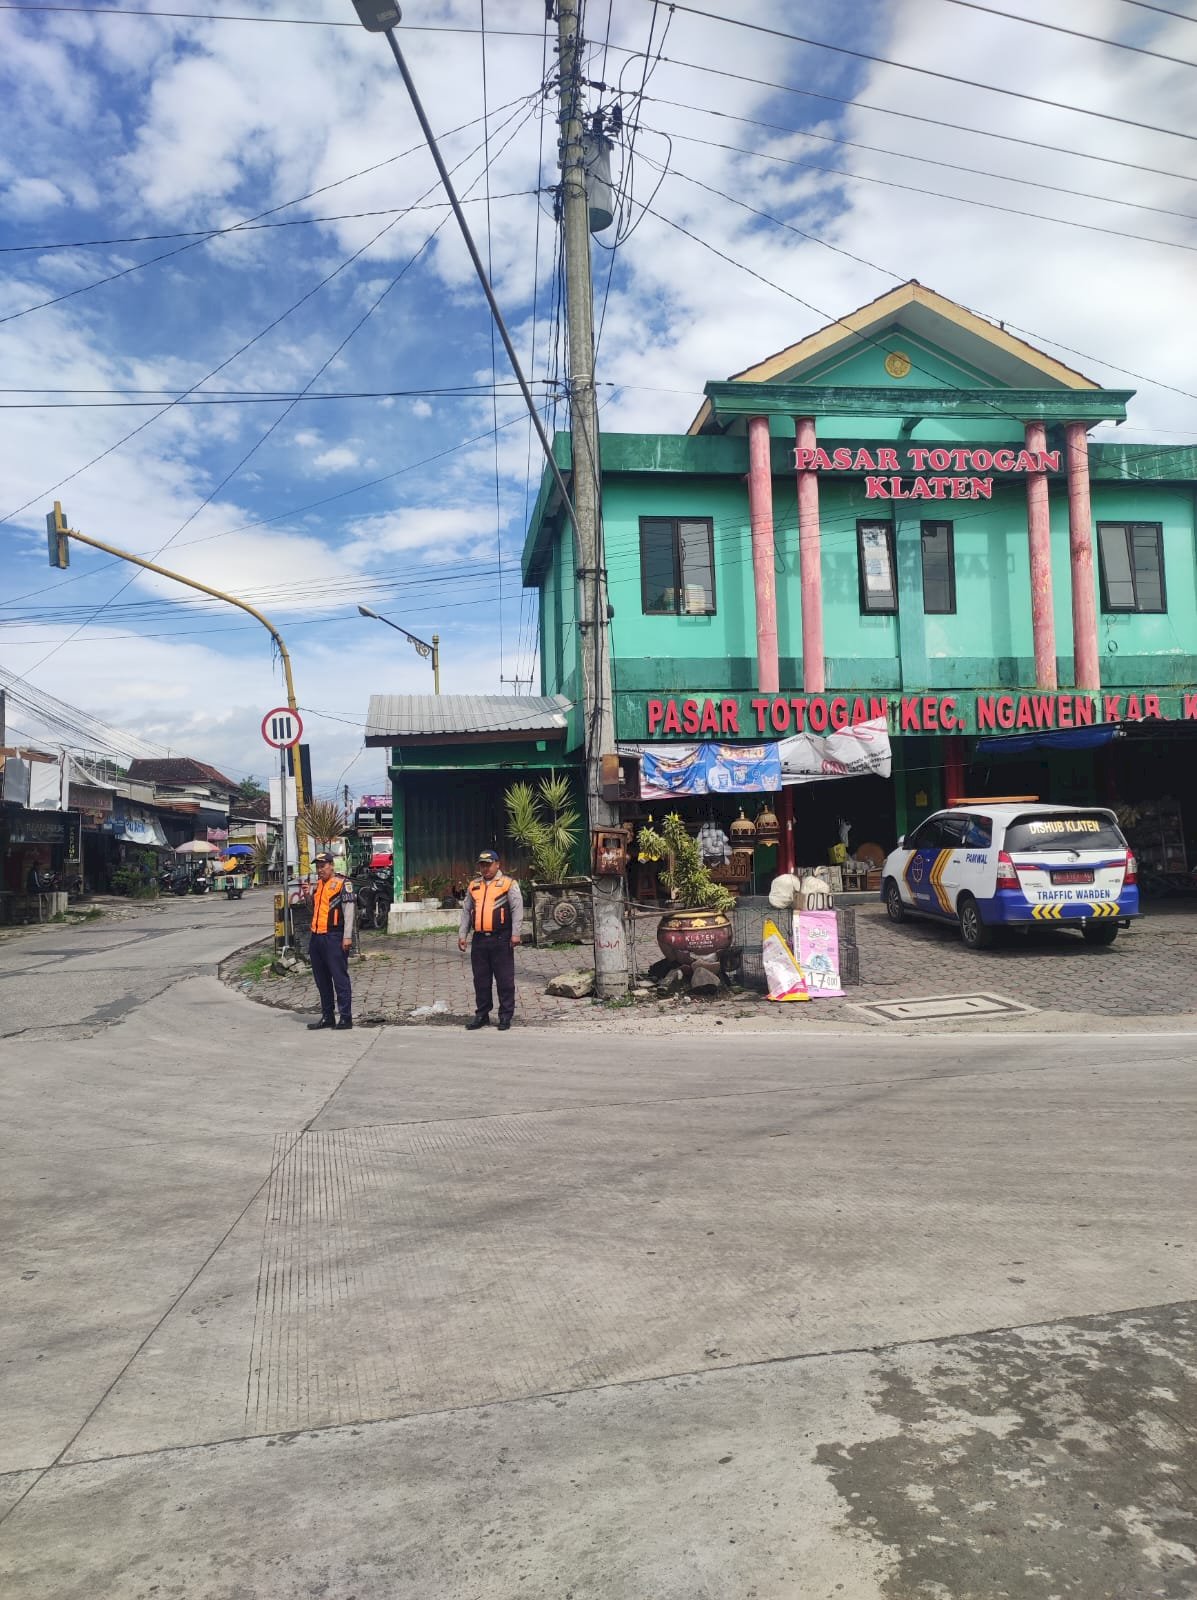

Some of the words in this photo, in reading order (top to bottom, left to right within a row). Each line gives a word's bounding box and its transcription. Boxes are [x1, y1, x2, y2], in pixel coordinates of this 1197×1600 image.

[793, 447, 901, 471] PASAR
[907, 448, 1061, 472] TOTOGAN
[864, 476, 994, 499] KLATEN
[647, 698, 740, 734] PASAR
[751, 696, 888, 732] TOTOGAN
[901, 696, 967, 730] KEC.
[977, 694, 1093, 730] NGAWEN
[1029, 821, 1064, 834] DISHUB
[1066, 820, 1100, 832] KLATEN
[965, 853, 988, 865] PAMWAL
[1037, 889, 1073, 901] TRAFFIC
[1076, 889, 1111, 900] WARDEN
[685, 934, 715, 942] KLATEN
